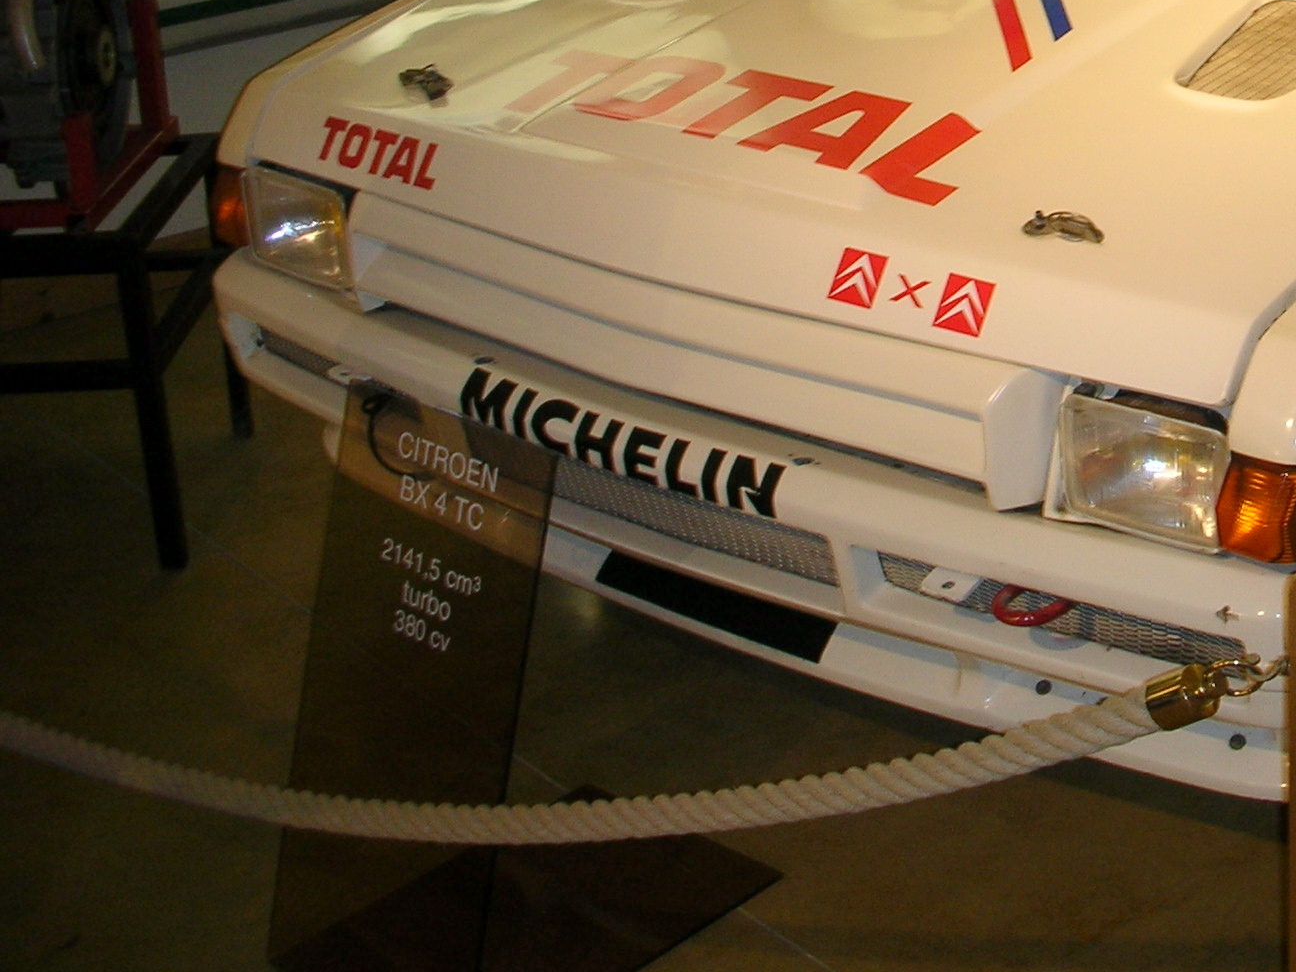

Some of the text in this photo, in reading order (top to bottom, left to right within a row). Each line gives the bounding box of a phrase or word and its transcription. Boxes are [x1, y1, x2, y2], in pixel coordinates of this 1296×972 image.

[318, 116, 441, 191] TOTAL
[502, 51, 983, 206] TOTAL
[398, 430, 499, 493] CITROEN
[461, 365, 787, 518] MICHELIN
[400, 474, 485, 531] BX 4 TC
[381, 537, 441, 581] 2141,5
[394, 609, 451, 652] 380 cv
[402, 579, 451, 622] turbo
